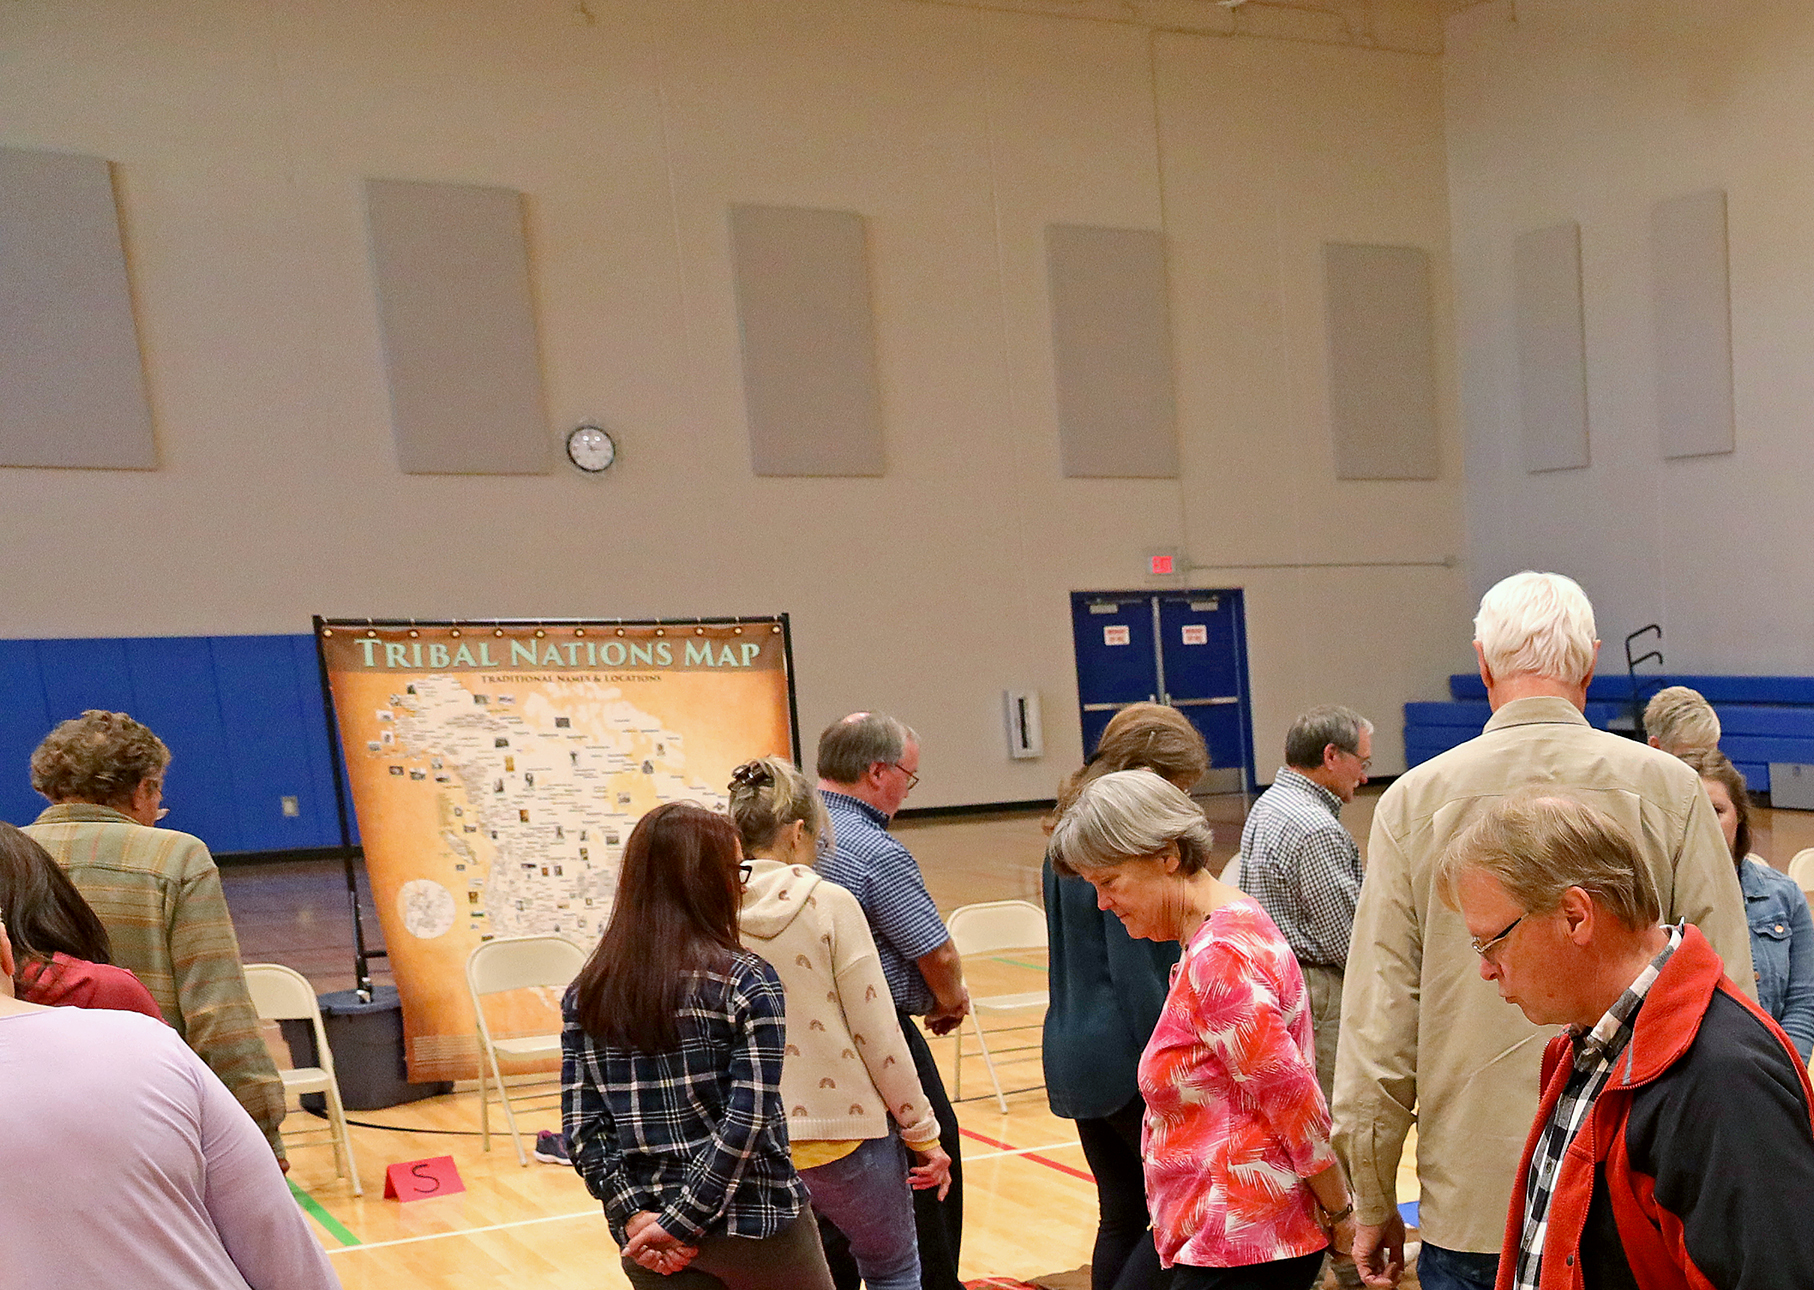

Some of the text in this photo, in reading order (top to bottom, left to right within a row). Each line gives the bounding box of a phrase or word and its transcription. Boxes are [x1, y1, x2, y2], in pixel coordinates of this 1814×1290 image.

[354, 638, 761, 669] TRIBAL NATIONS MAP
[481, 674, 662, 684] TRADITIONAL NAMES & LOCATIONS
[411, 1163, 440, 1194] S
